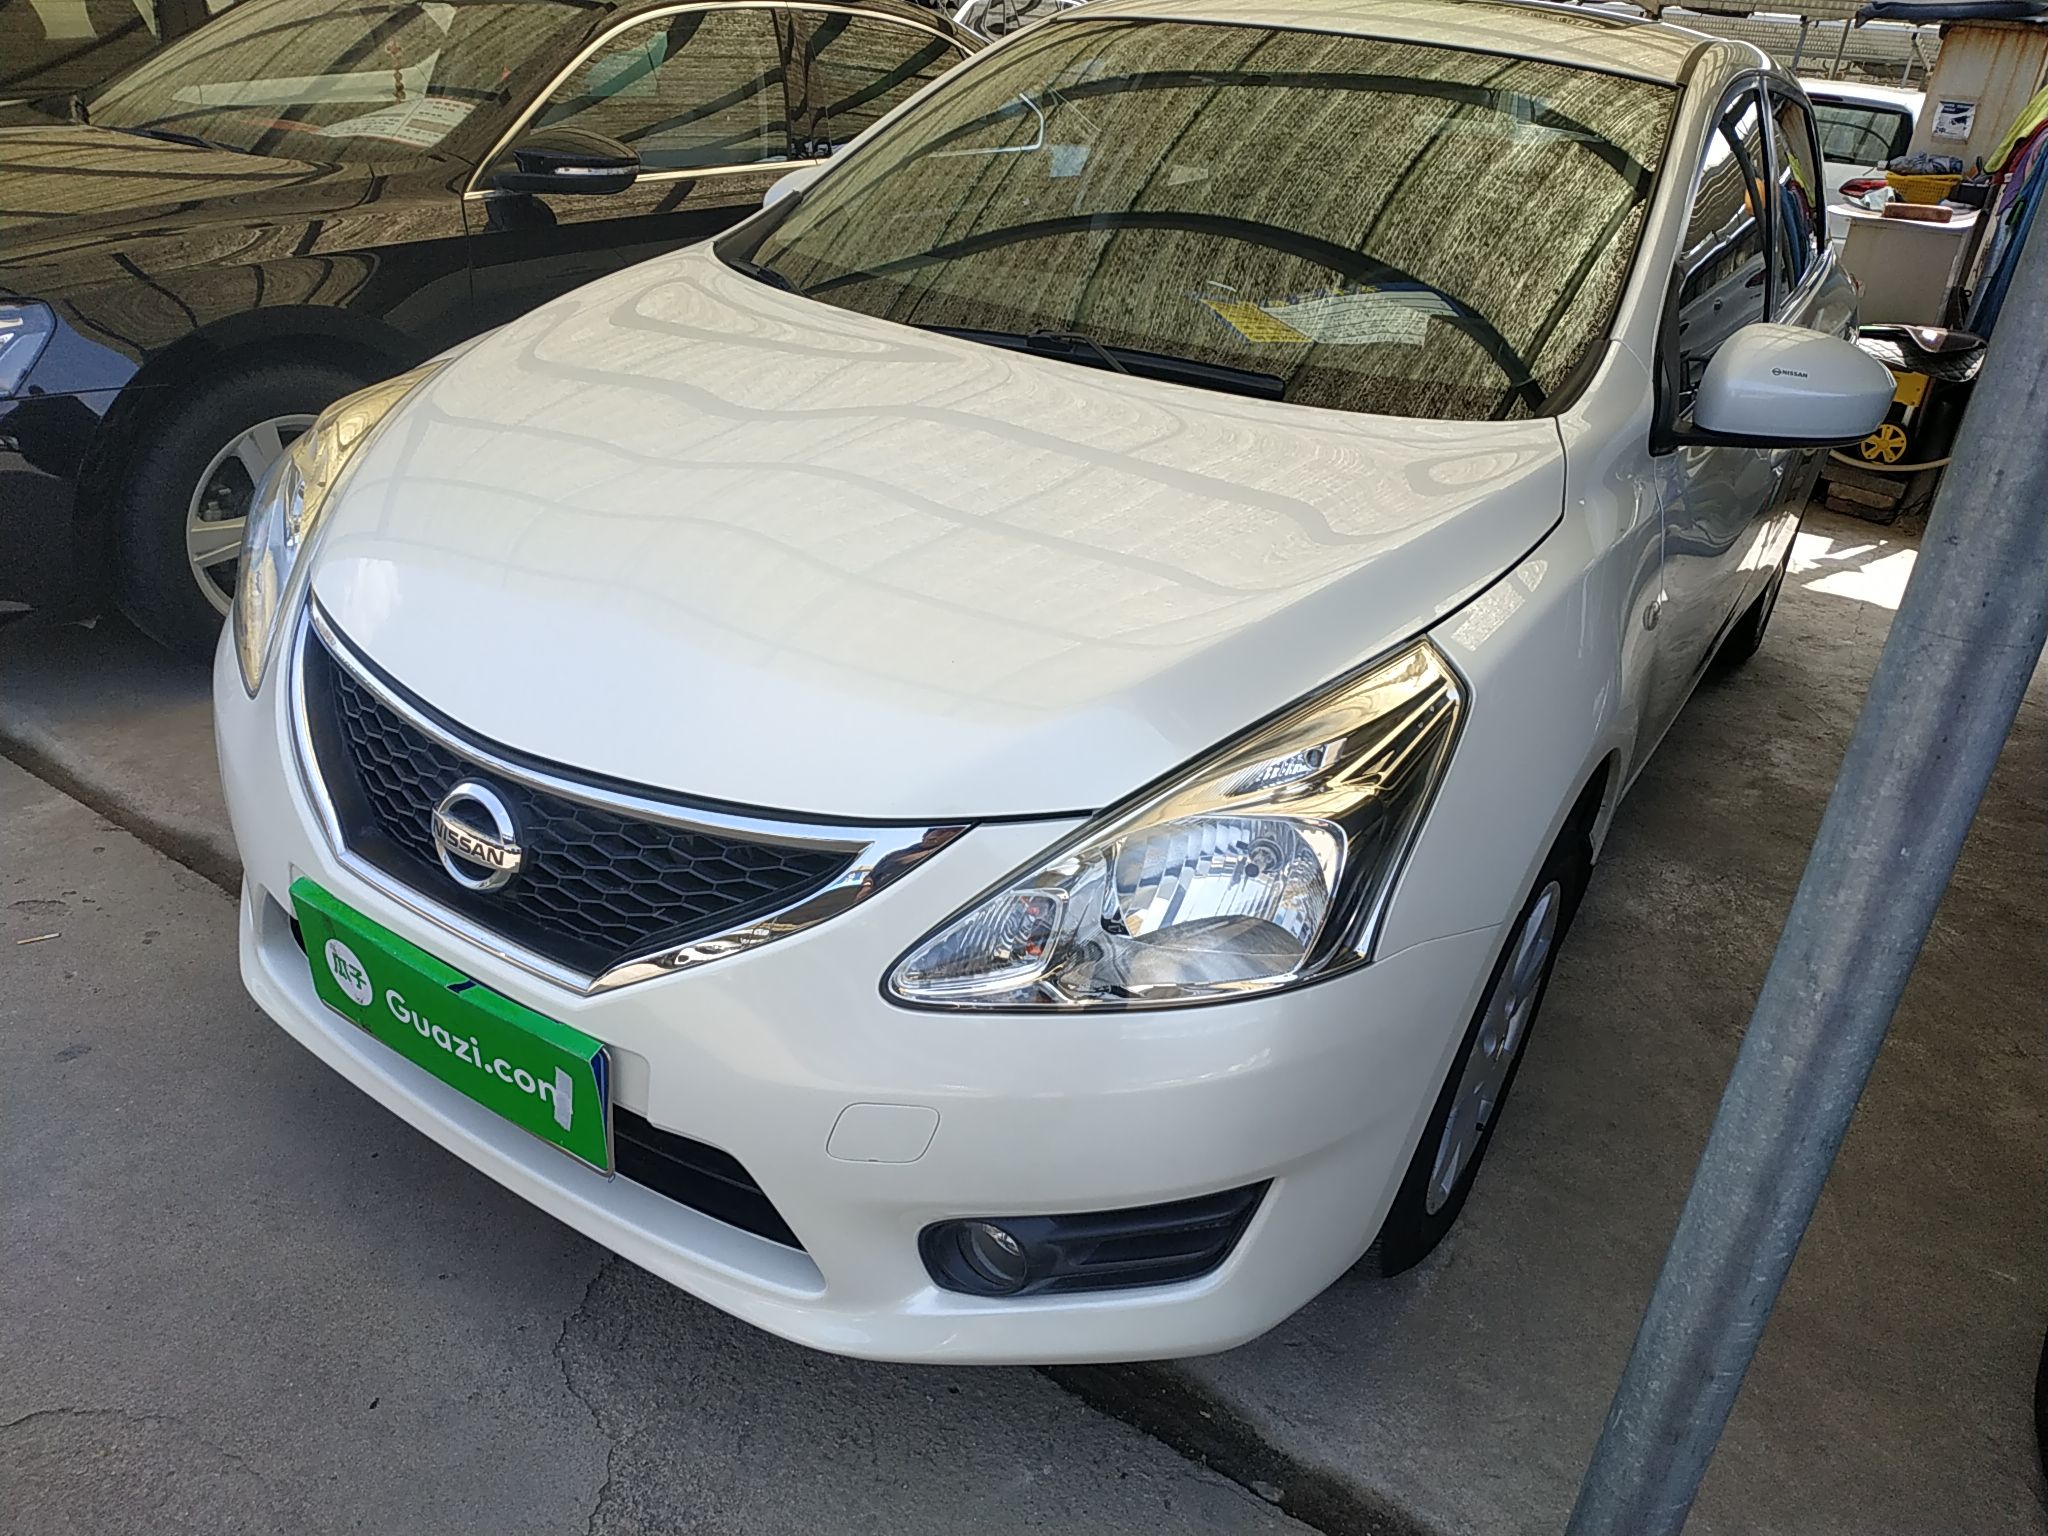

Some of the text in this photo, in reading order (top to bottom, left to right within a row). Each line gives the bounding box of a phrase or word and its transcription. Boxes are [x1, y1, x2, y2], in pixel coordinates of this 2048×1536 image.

[1782, 369, 1808, 378] NISSAN
[433, 815, 505, 866] NISSAN
[332, 952, 367, 990] 瓜子
